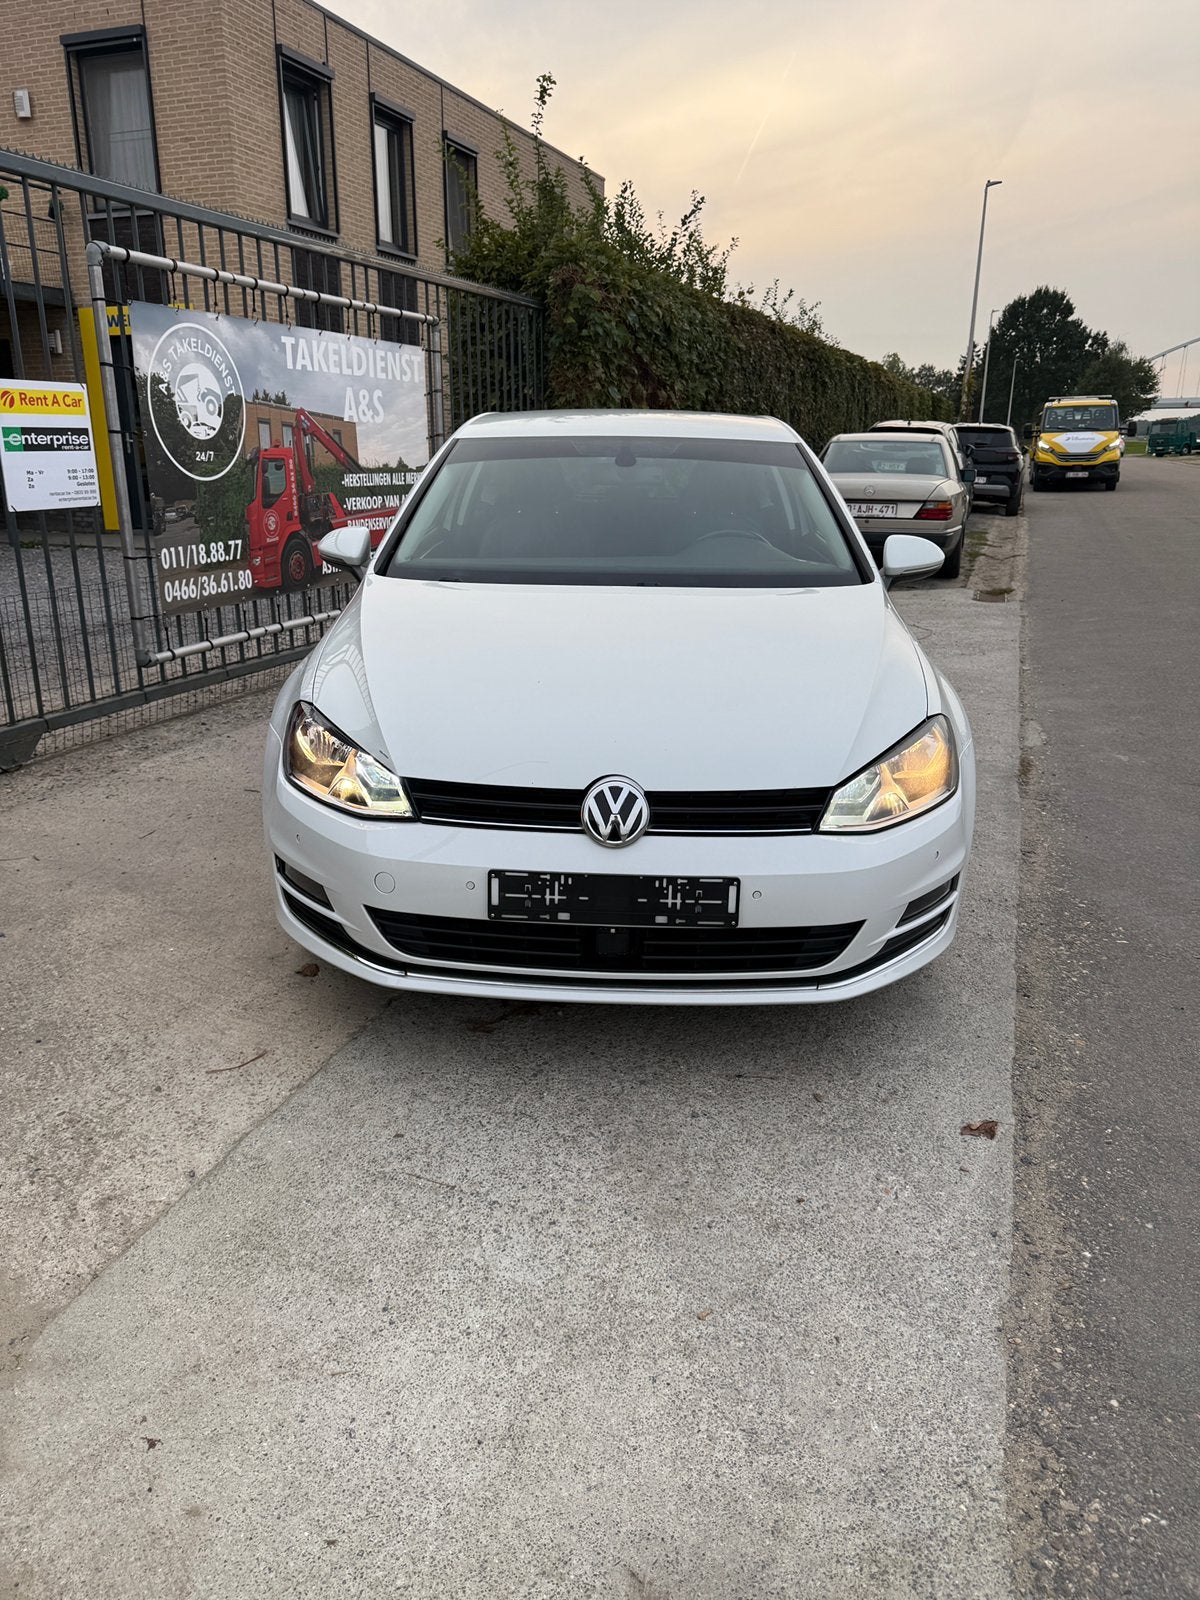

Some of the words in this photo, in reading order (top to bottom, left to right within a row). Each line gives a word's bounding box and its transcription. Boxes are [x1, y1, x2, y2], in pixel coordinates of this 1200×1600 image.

[158, 358, 173, 396] A&S
[168, 338, 236, 397] TAKELDIENST
[281, 335, 421, 383] TAKELDIENST
[19, 392, 49, 407] Rent
[51, 394, 61, 407] A
[62, 394, 82, 408] Car
[343, 387, 385, 424] A&S
[7, 432, 89, 448] enterprise
[195, 451, 214, 461] 24/7
[392, 472, 404, 485] ALLE
[384, 495, 400, 508] VAN
[161, 539, 242, 570] 011/18.88.77
[164, 569, 252, 603] 0466/36.61.80
